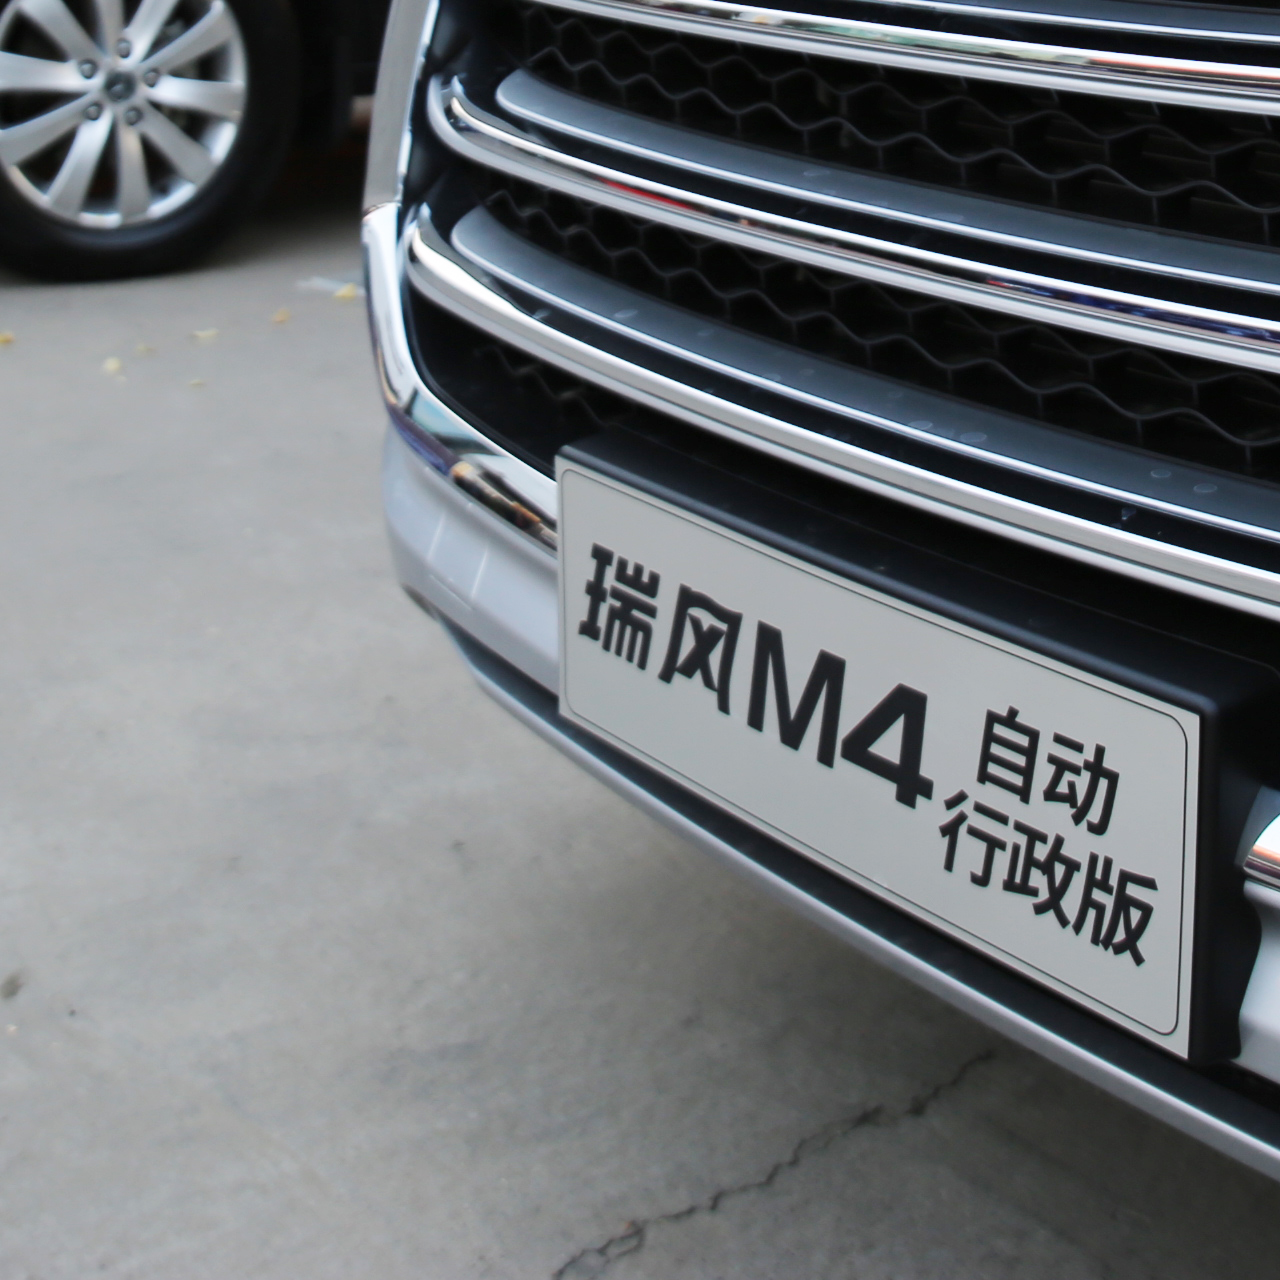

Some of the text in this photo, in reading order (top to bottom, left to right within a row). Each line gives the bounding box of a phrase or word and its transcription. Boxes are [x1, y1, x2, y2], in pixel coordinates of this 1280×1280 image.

[578, 542, 934, 810] 瑞风M4
[977, 705, 1120, 836] 自动
[939, 789, 1158, 967] 行政版
